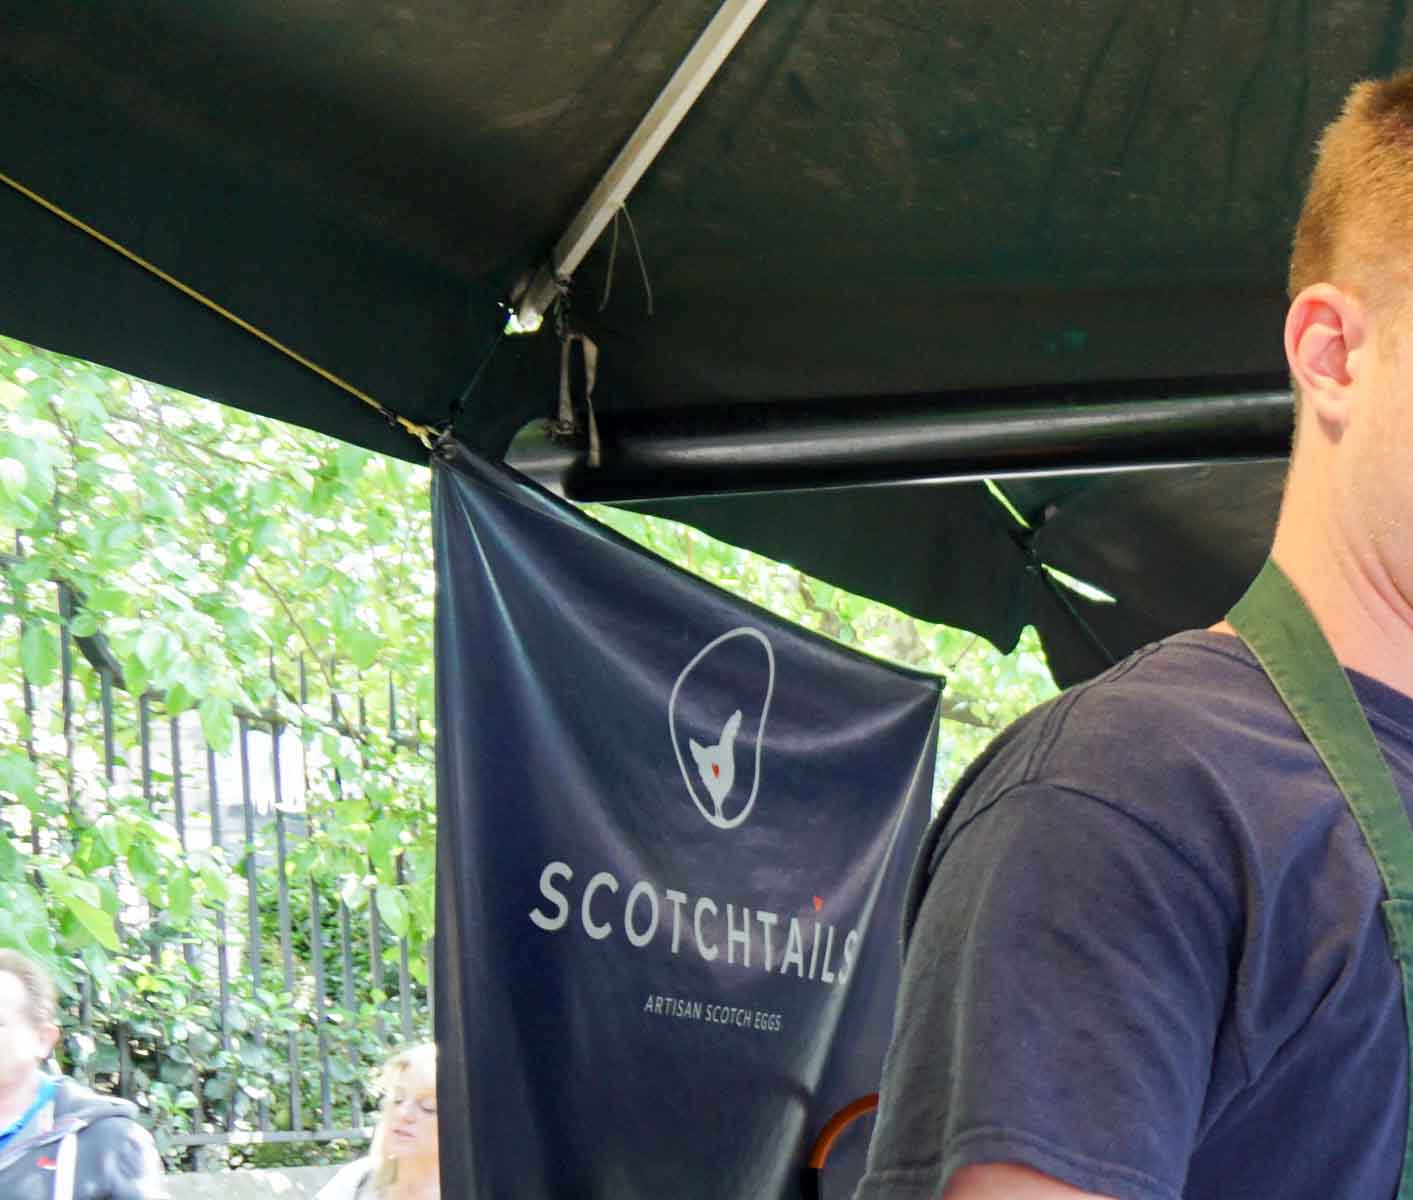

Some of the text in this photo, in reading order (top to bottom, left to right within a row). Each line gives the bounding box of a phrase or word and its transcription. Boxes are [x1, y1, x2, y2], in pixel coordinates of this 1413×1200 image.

[528, 861, 859, 985] SCOTCHTAILS
[644, 993, 782, 1032] ARTISAN SCOTCH EGGS
